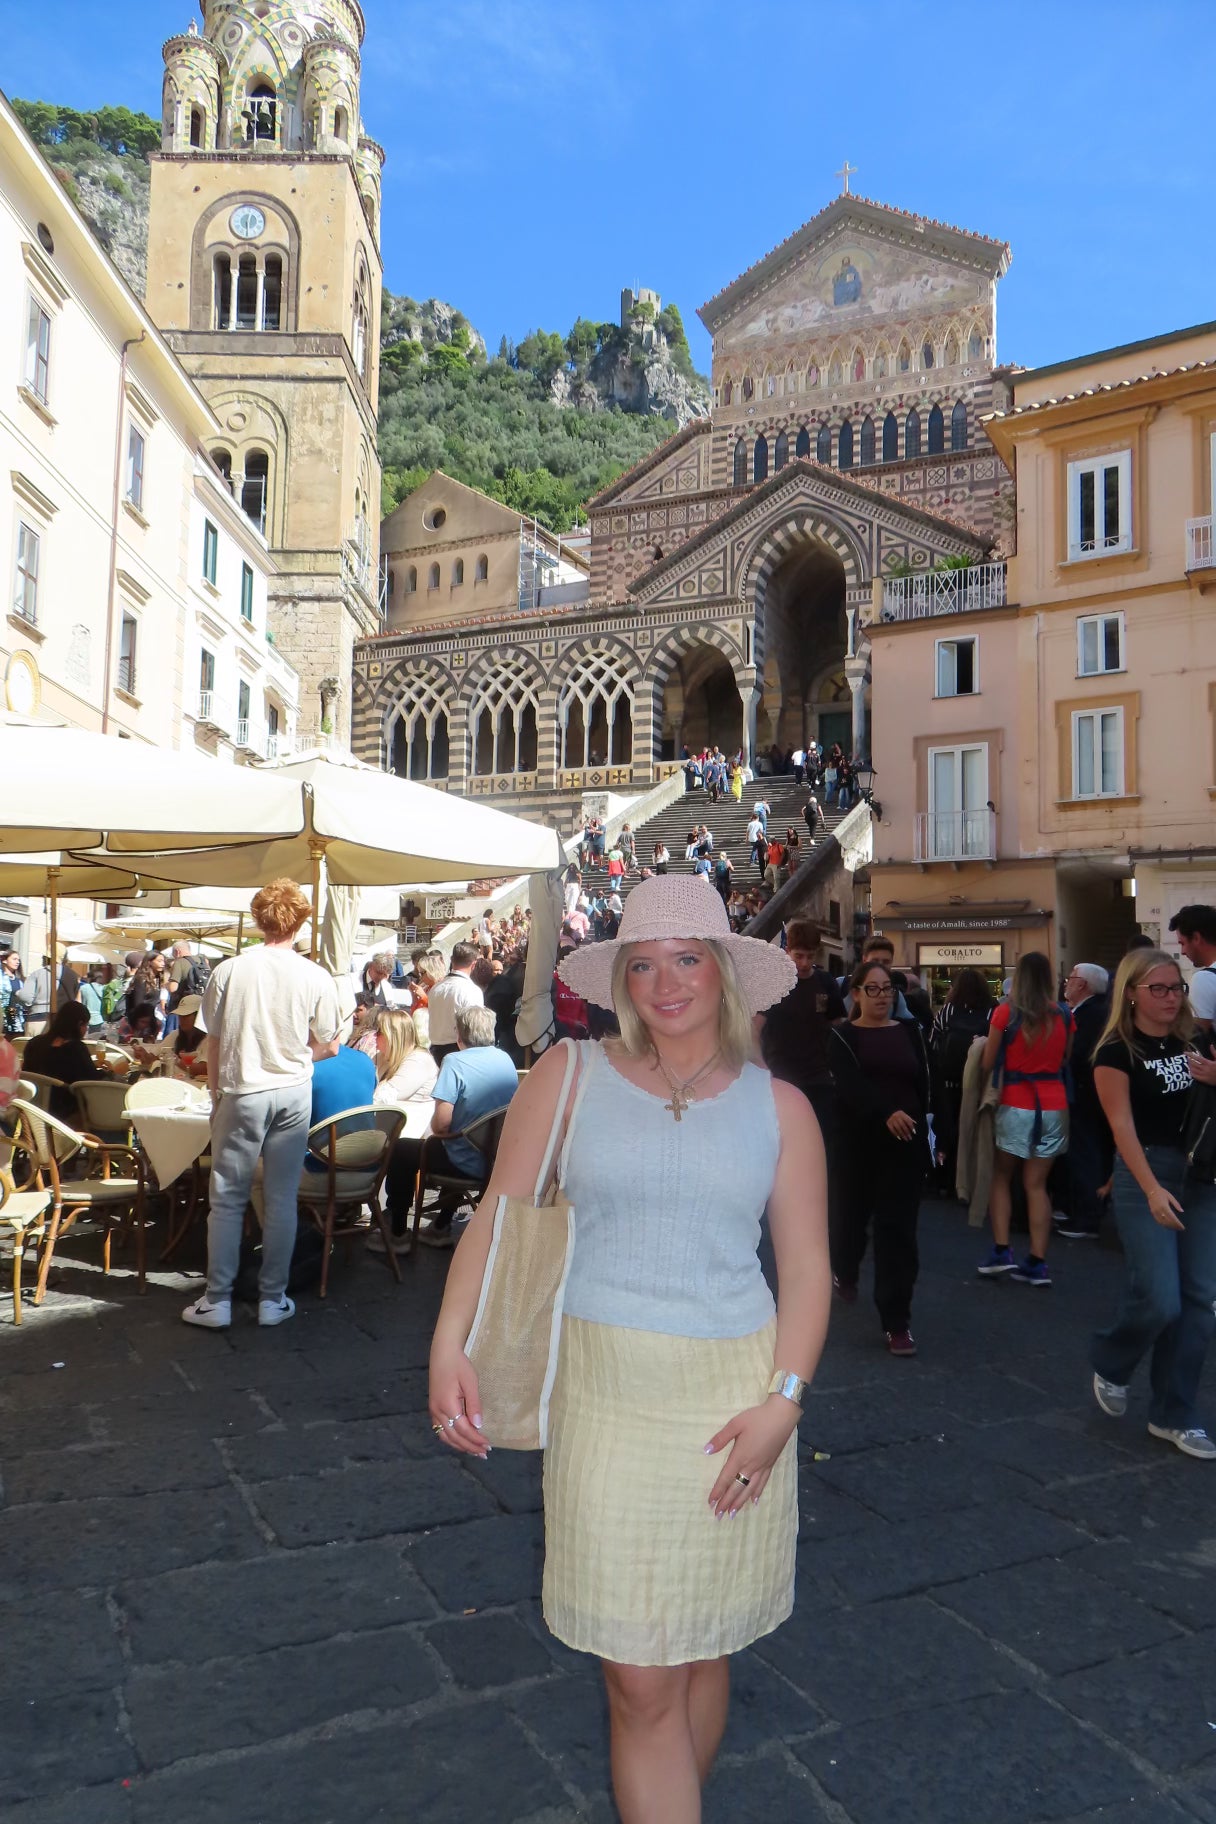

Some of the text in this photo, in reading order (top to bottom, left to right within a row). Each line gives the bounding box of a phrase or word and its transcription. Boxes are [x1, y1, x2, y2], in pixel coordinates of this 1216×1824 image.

[913, 921, 931, 929] taste
[931, 920, 940, 928] of
[940, 920, 968, 929] Amalfi,
[969, 919, 989, 927] since
[937, 948, 983, 957] COBALTO
[1143, 1059, 1164, 1070] WE
[1156, 1064, 1183, 1076] AND
